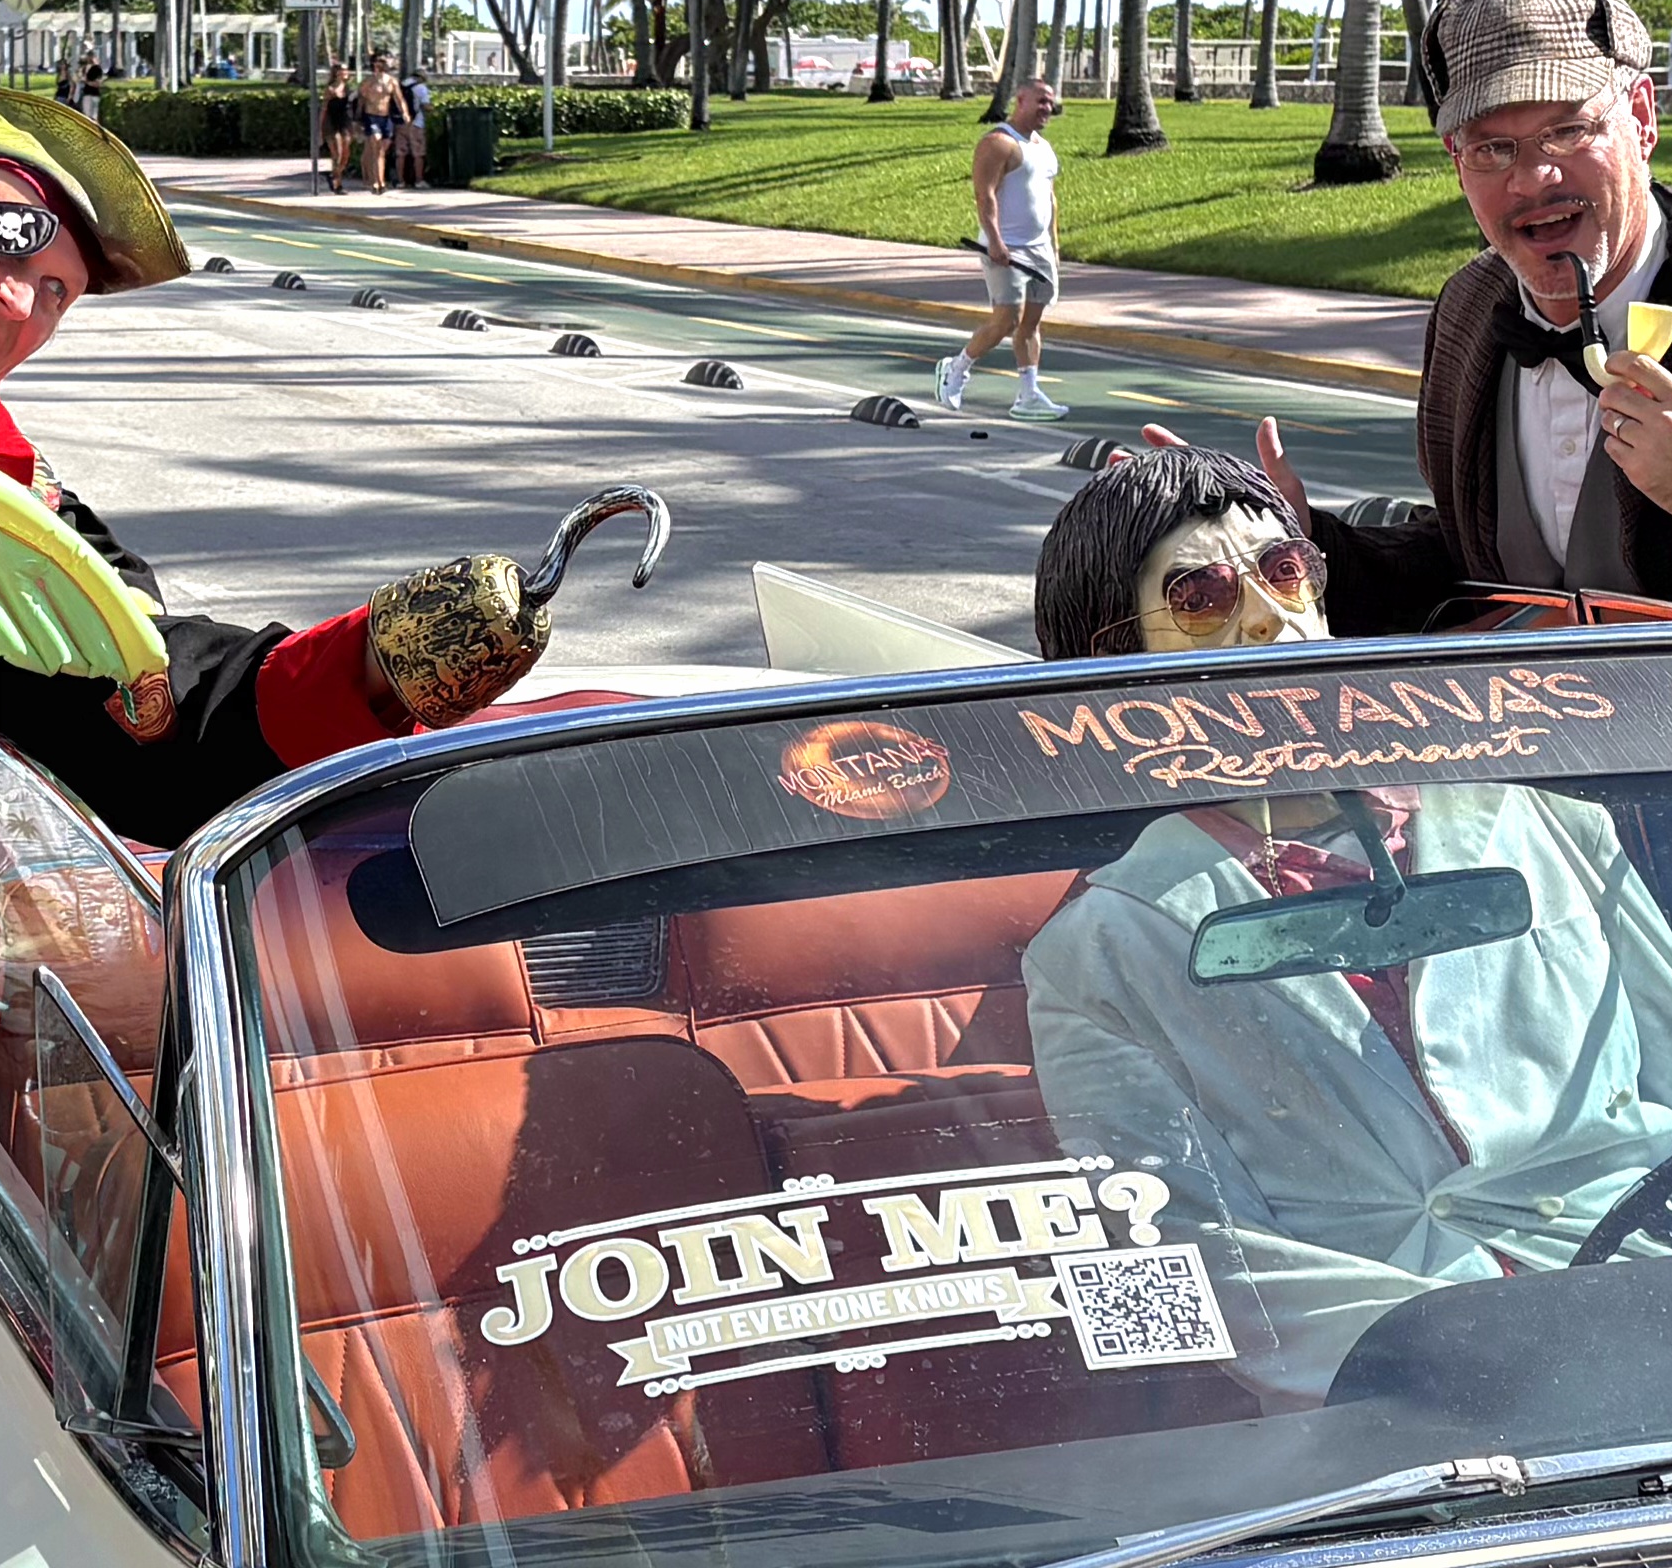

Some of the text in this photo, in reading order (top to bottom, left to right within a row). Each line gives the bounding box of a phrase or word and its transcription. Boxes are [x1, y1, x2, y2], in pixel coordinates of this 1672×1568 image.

[1019, 668, 1616, 756] MONTANA'S
[816, 765, 945, 808] Miami Beach
[1124, 727, 1552, 788] Restaurant
[481, 1171, 1171, 1346] JOIN ME?
[664, 1275, 1008, 1351] NOT EVERYONE KNOWS
